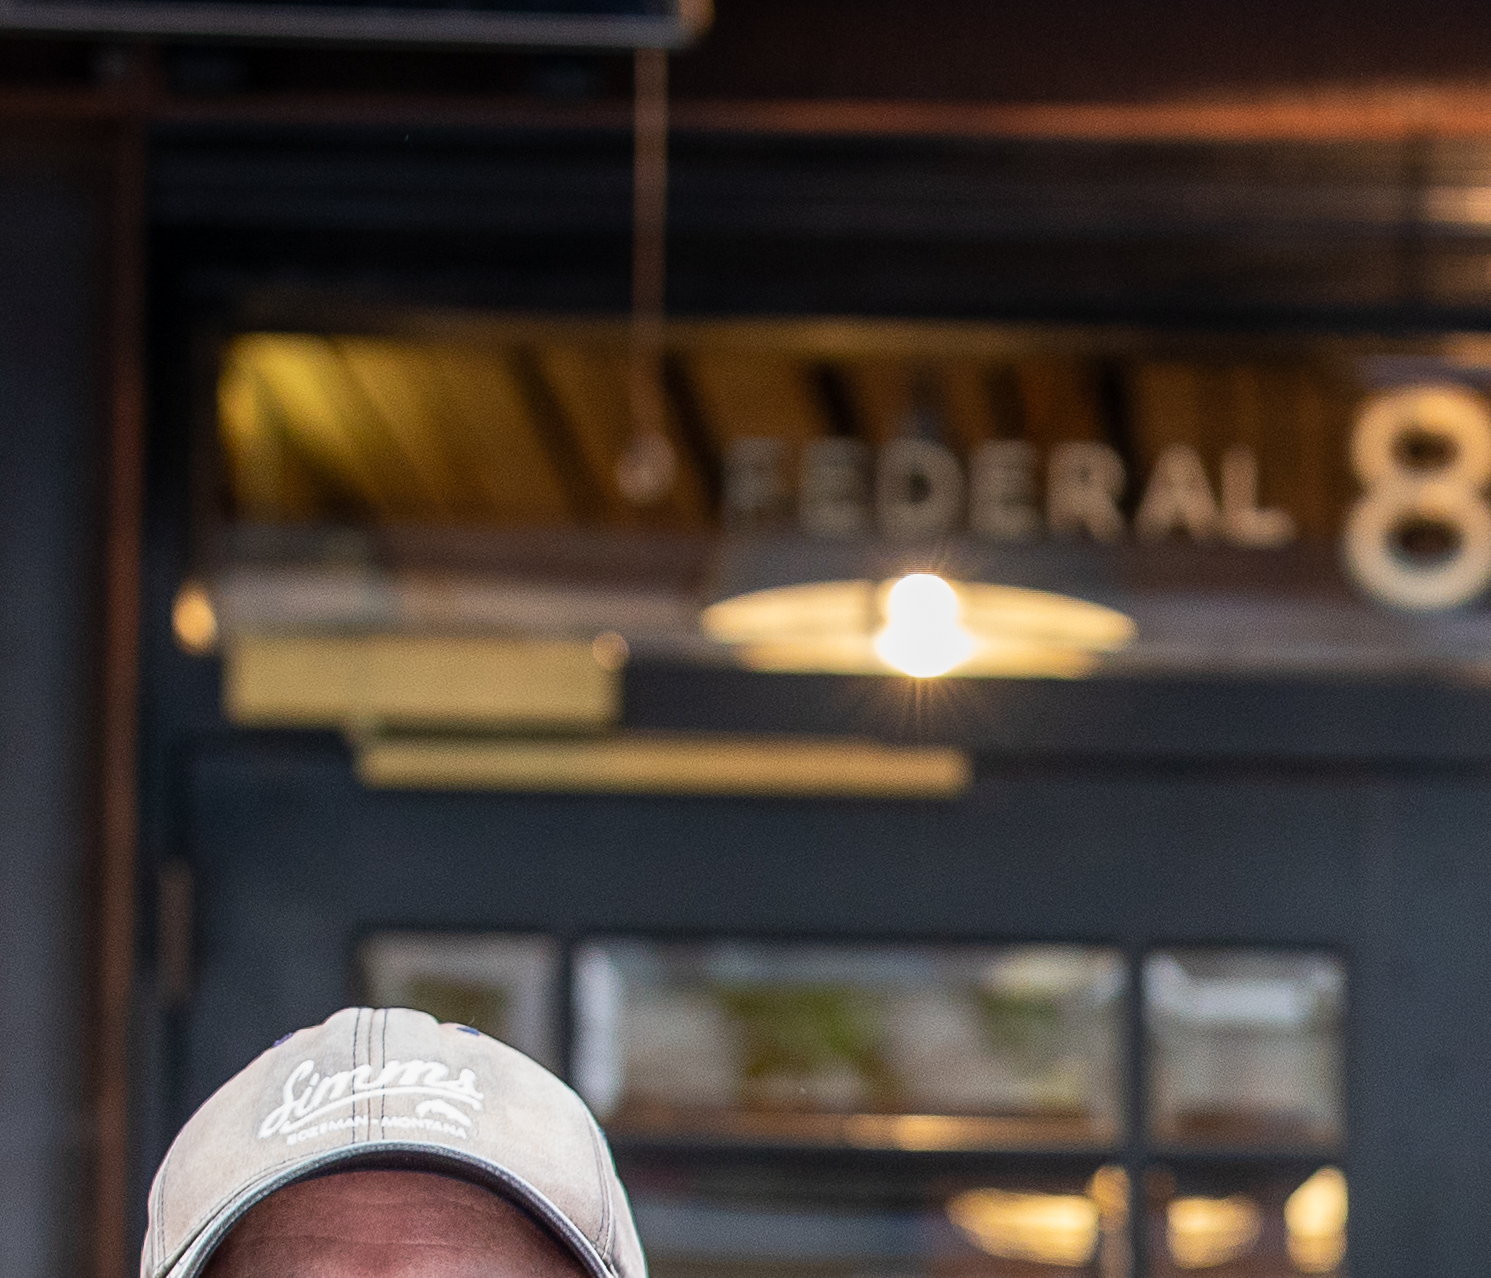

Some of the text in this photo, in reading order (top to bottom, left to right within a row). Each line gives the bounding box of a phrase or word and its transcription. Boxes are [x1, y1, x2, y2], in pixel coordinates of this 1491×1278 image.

[722, 437, 1296, 547] FEDERAL
[259, 1060, 485, 1139] Simms
[381, 1116, 467, 1139] MONTANA
